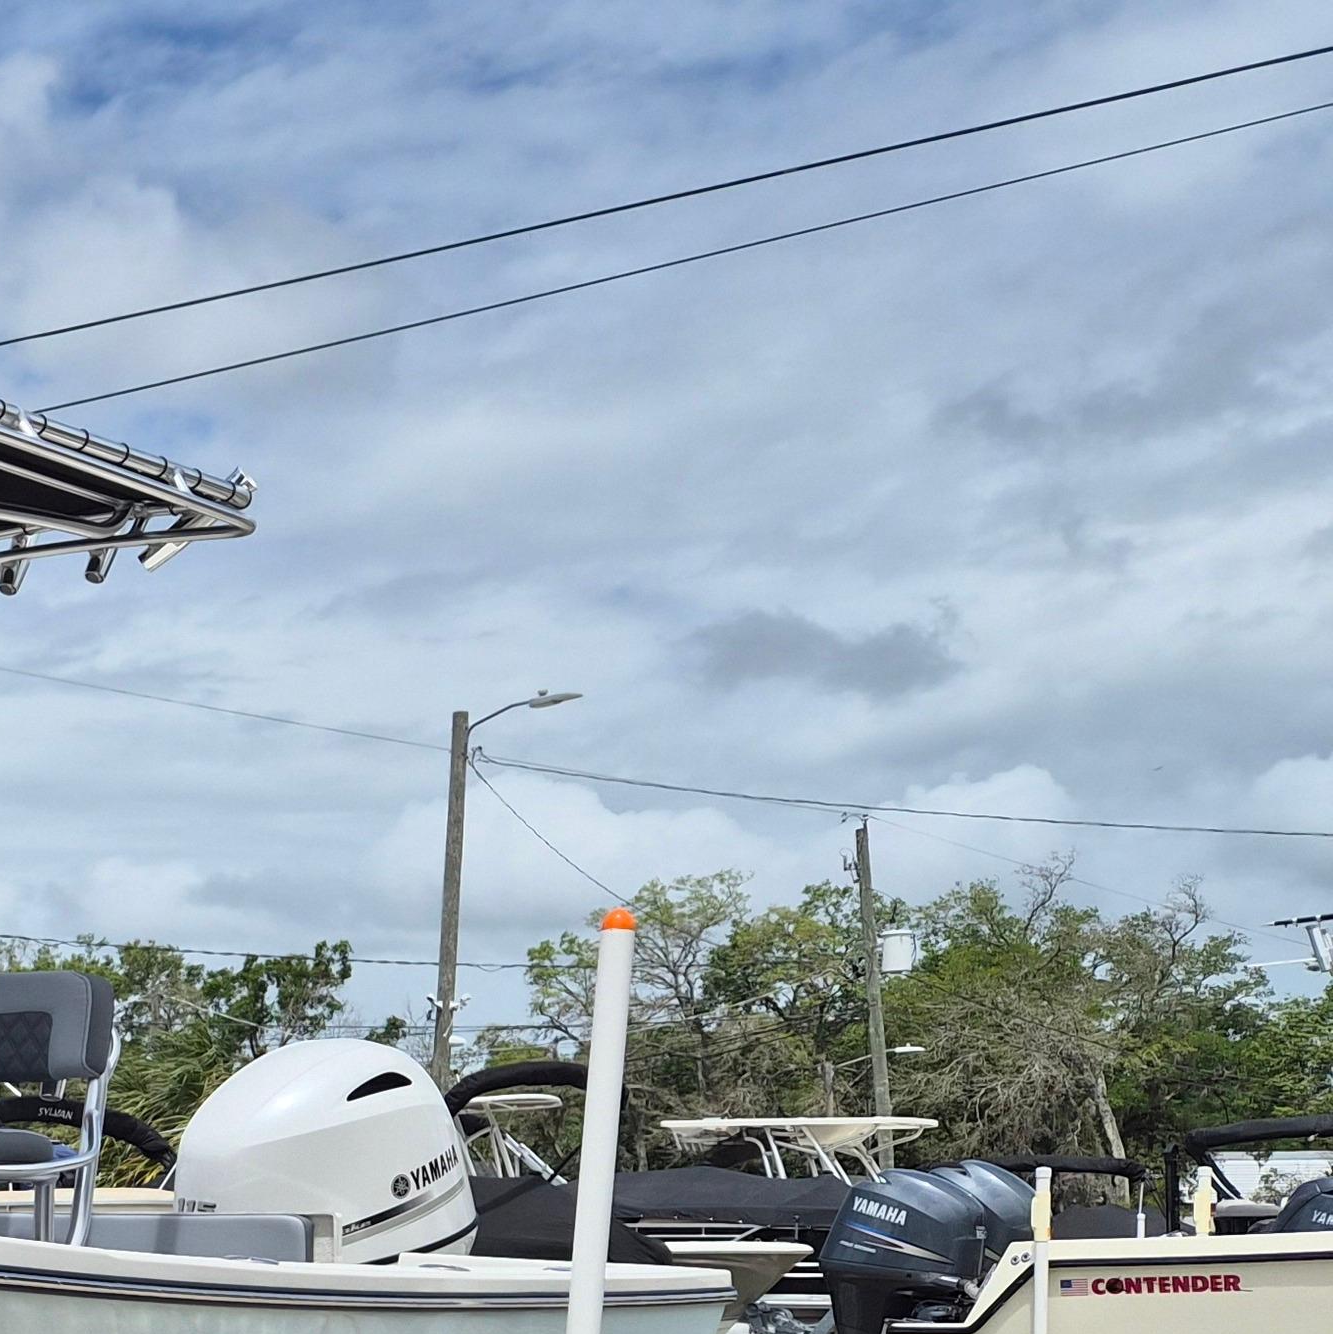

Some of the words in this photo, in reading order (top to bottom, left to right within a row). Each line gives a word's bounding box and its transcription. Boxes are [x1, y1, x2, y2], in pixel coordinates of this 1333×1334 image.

[411, 1145, 459, 1190] YAMAHA
[853, 1196, 907, 1226] YAMAHA
[1091, 1274, 1242, 1296] CONTENDER
